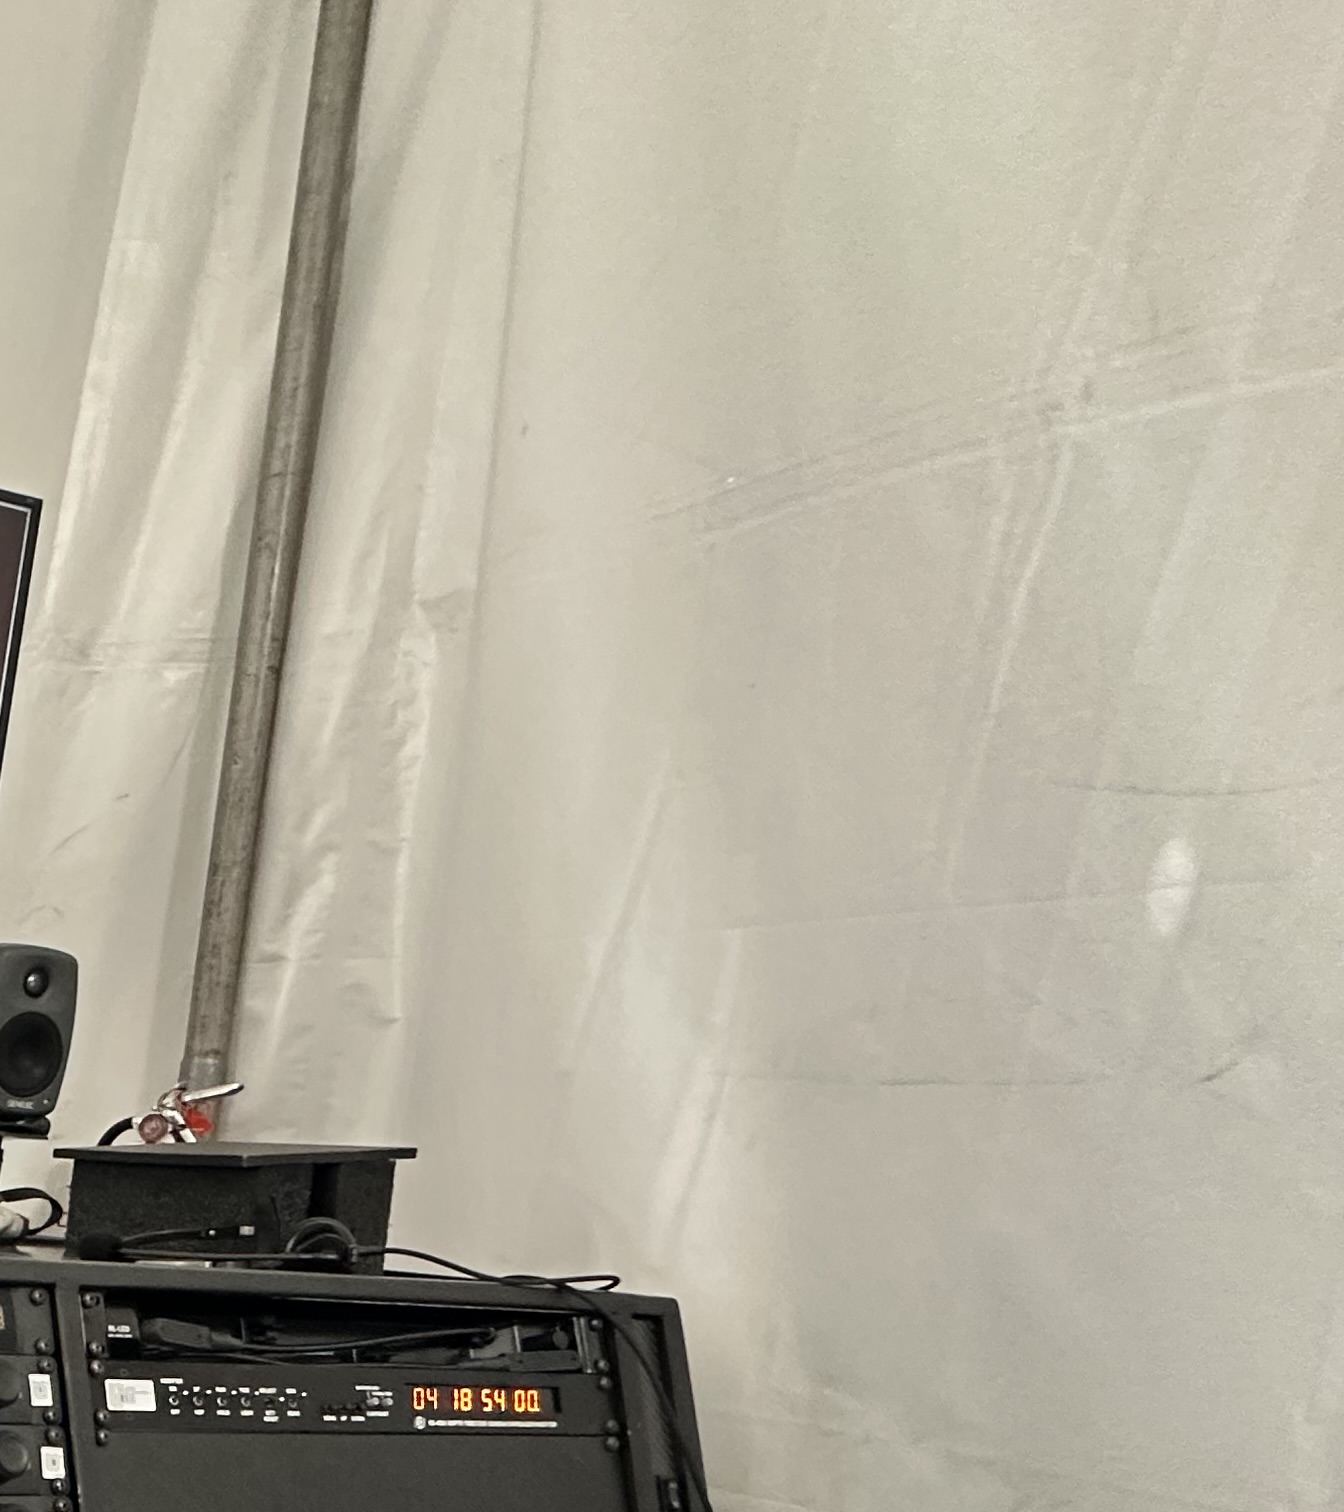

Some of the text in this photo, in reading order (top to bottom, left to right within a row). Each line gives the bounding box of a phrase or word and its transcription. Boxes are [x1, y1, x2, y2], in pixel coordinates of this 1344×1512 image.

[413, 1387, 438, 1410] 04
[453, 1387, 472, 1412] 18
[481, 1388, 506, 1412] 54
